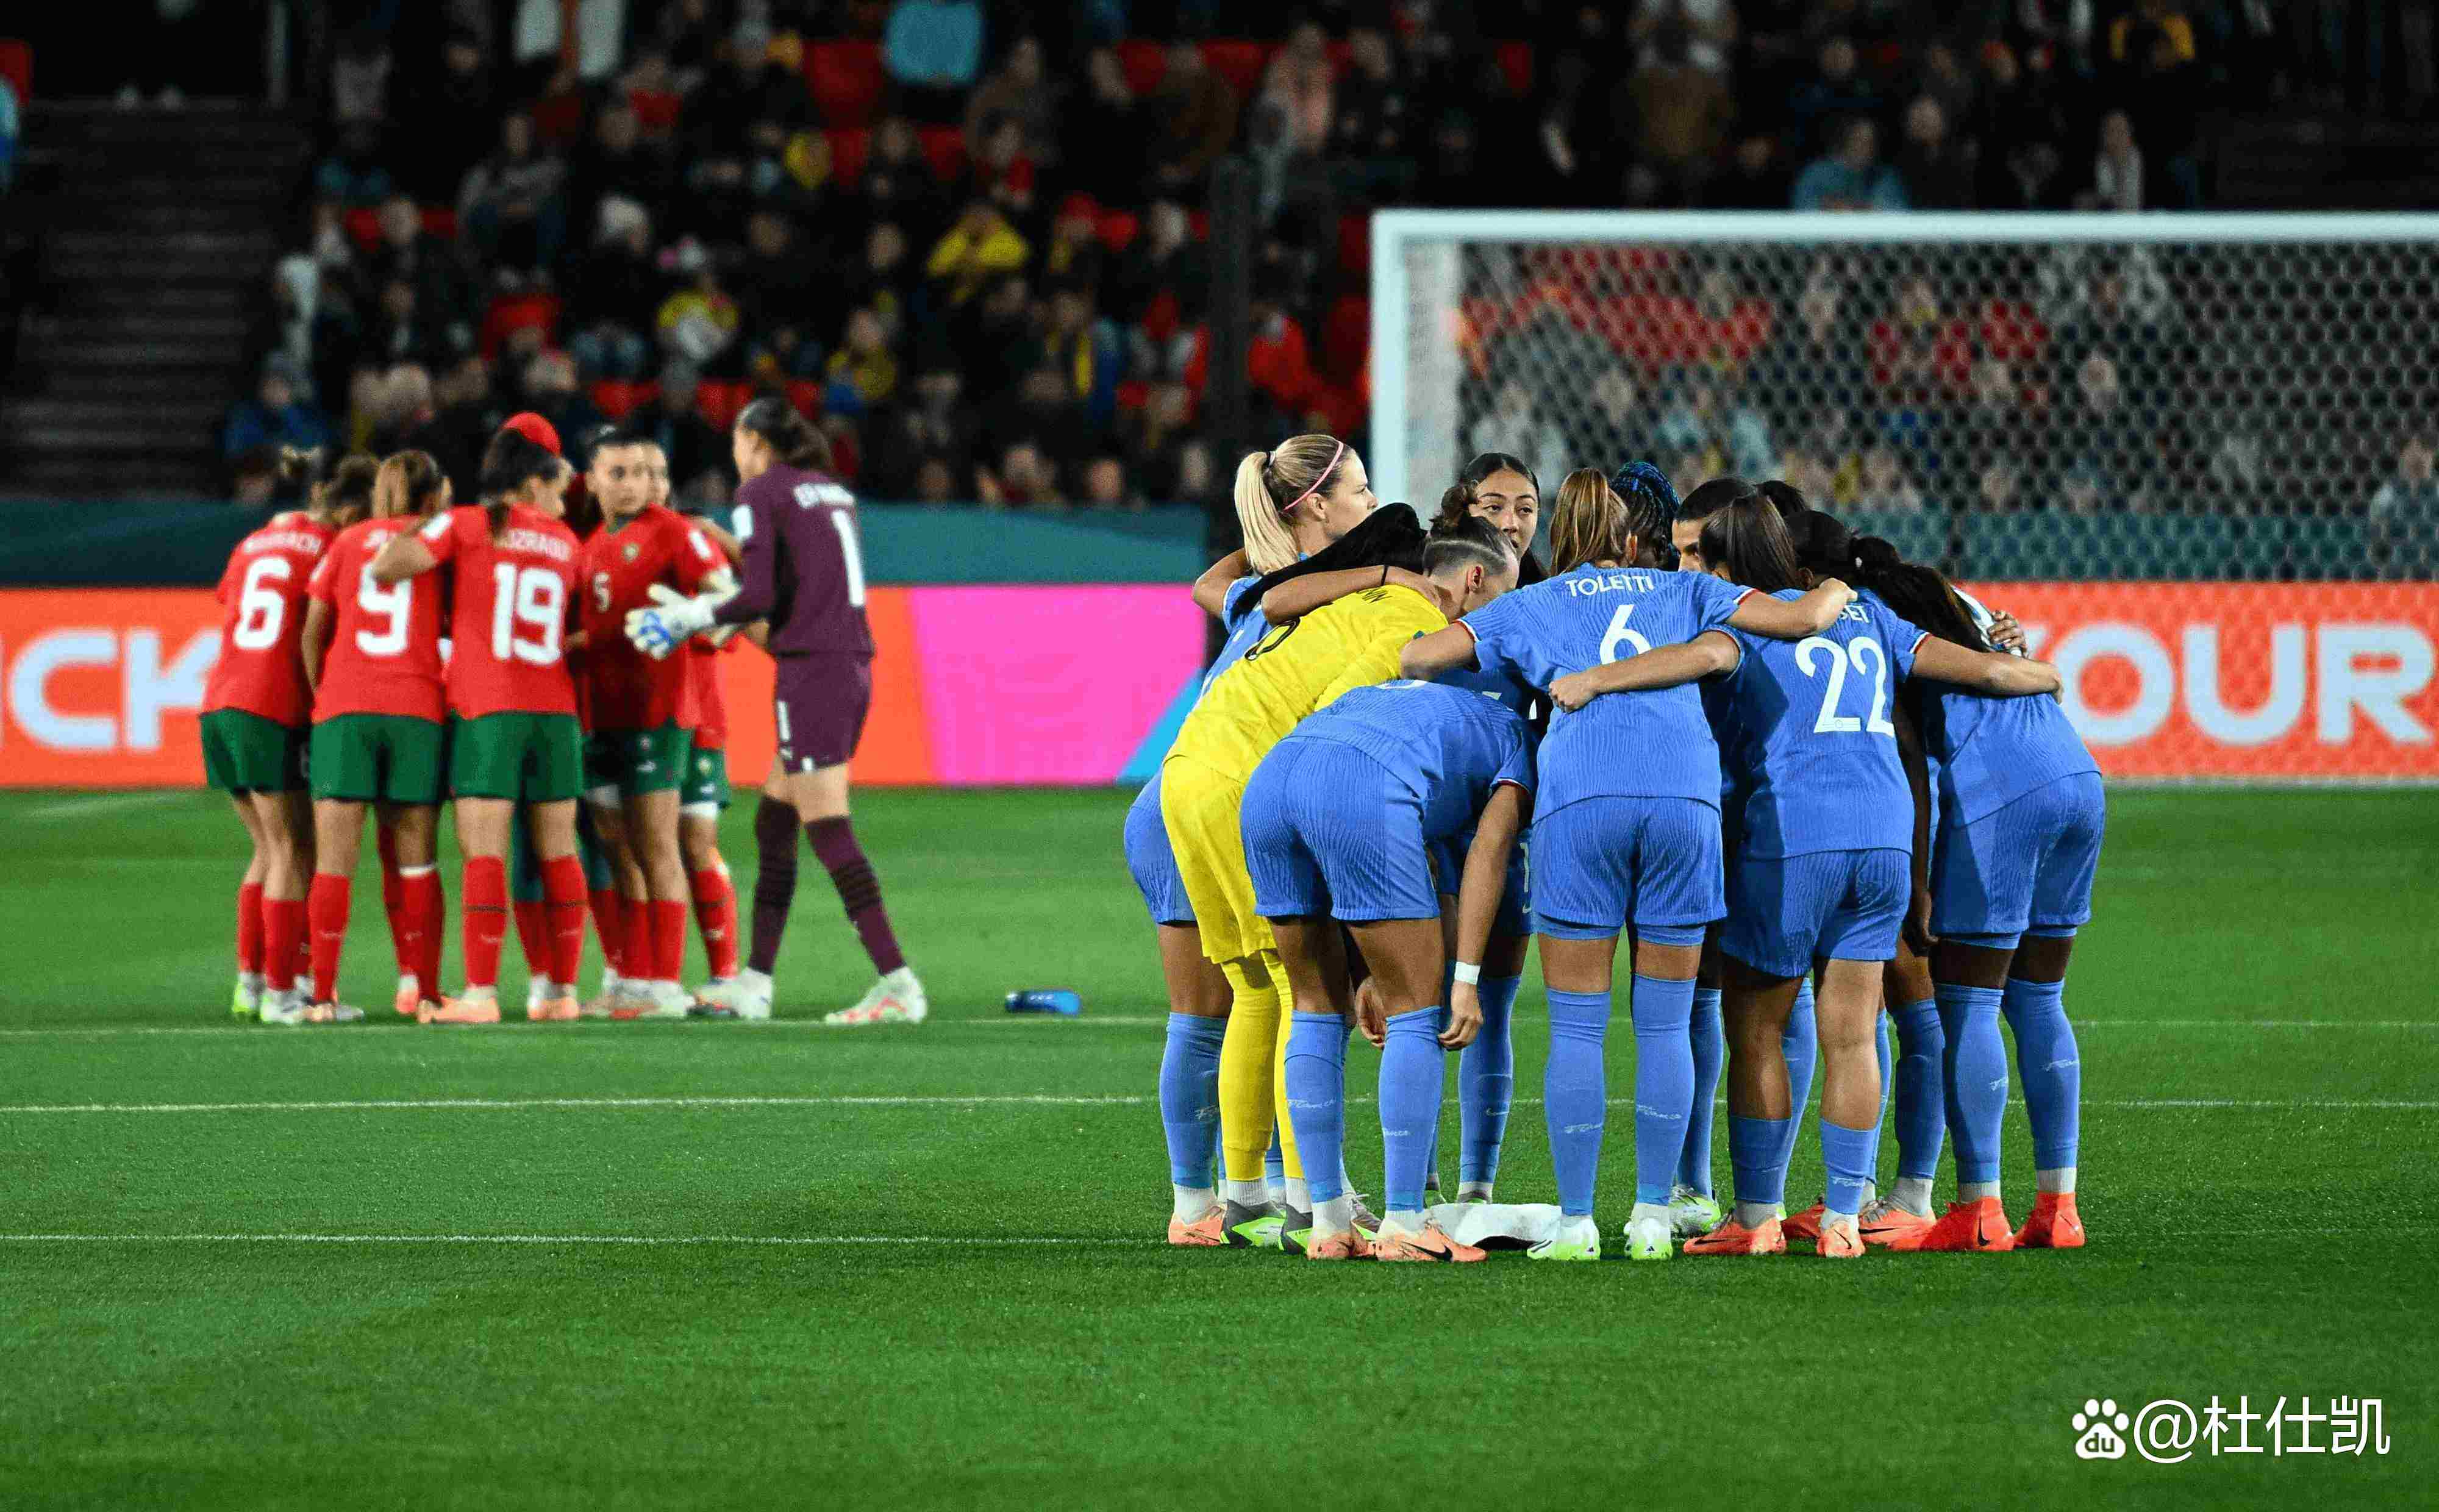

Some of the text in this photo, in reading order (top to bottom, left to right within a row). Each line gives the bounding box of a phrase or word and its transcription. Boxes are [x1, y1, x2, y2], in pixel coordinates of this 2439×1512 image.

[234, 556, 291, 651] 6
[832, 509, 864, 607] 1
[1565, 575, 1654, 597] TOLETTI
[356, 562, 412, 656] 9
[493, 562, 564, 665] 19
[1600, 604, 1651, 665] 6
[0, 629, 223, 752] CK
[1794, 636, 1894, 738] 22
